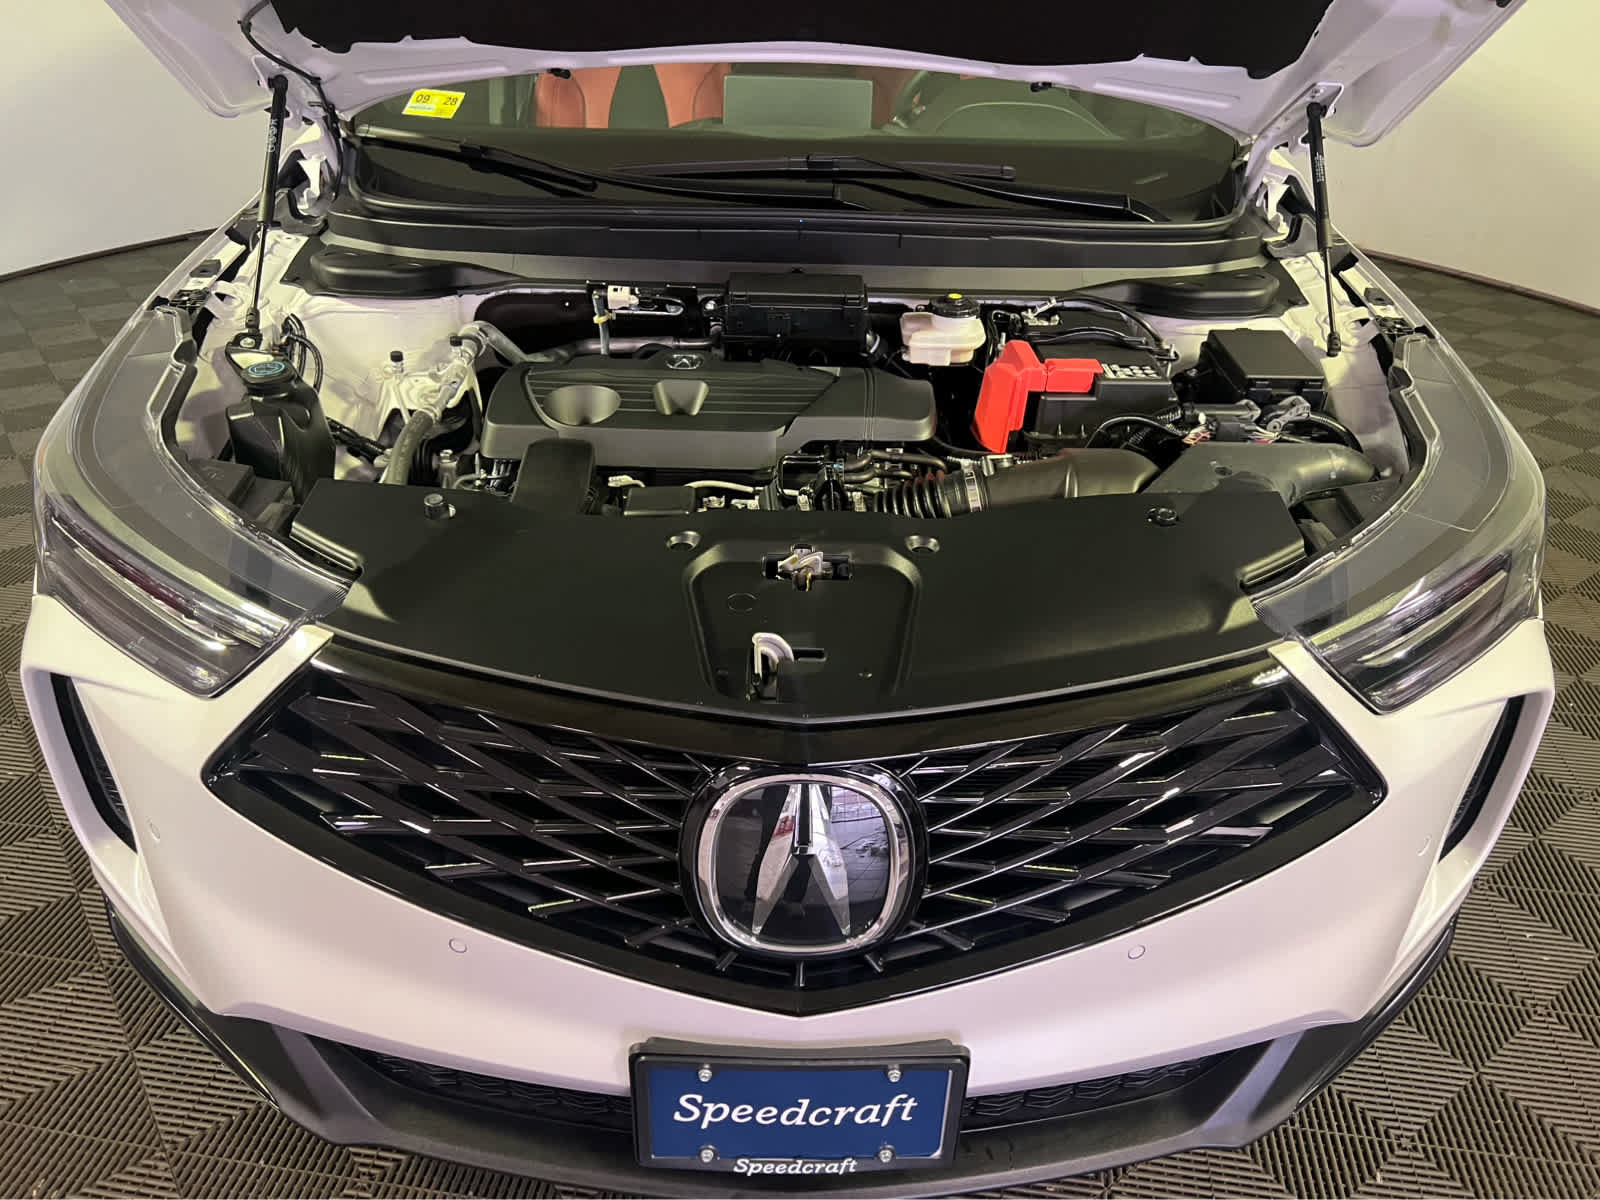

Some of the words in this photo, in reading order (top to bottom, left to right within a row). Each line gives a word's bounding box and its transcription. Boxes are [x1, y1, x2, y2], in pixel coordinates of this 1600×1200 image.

[416, 94, 431, 104] 09
[443, 96, 459, 106] 28
[673, 1093, 918, 1129] Speedcraft
[733, 1157, 858, 1176] Speedcraft
